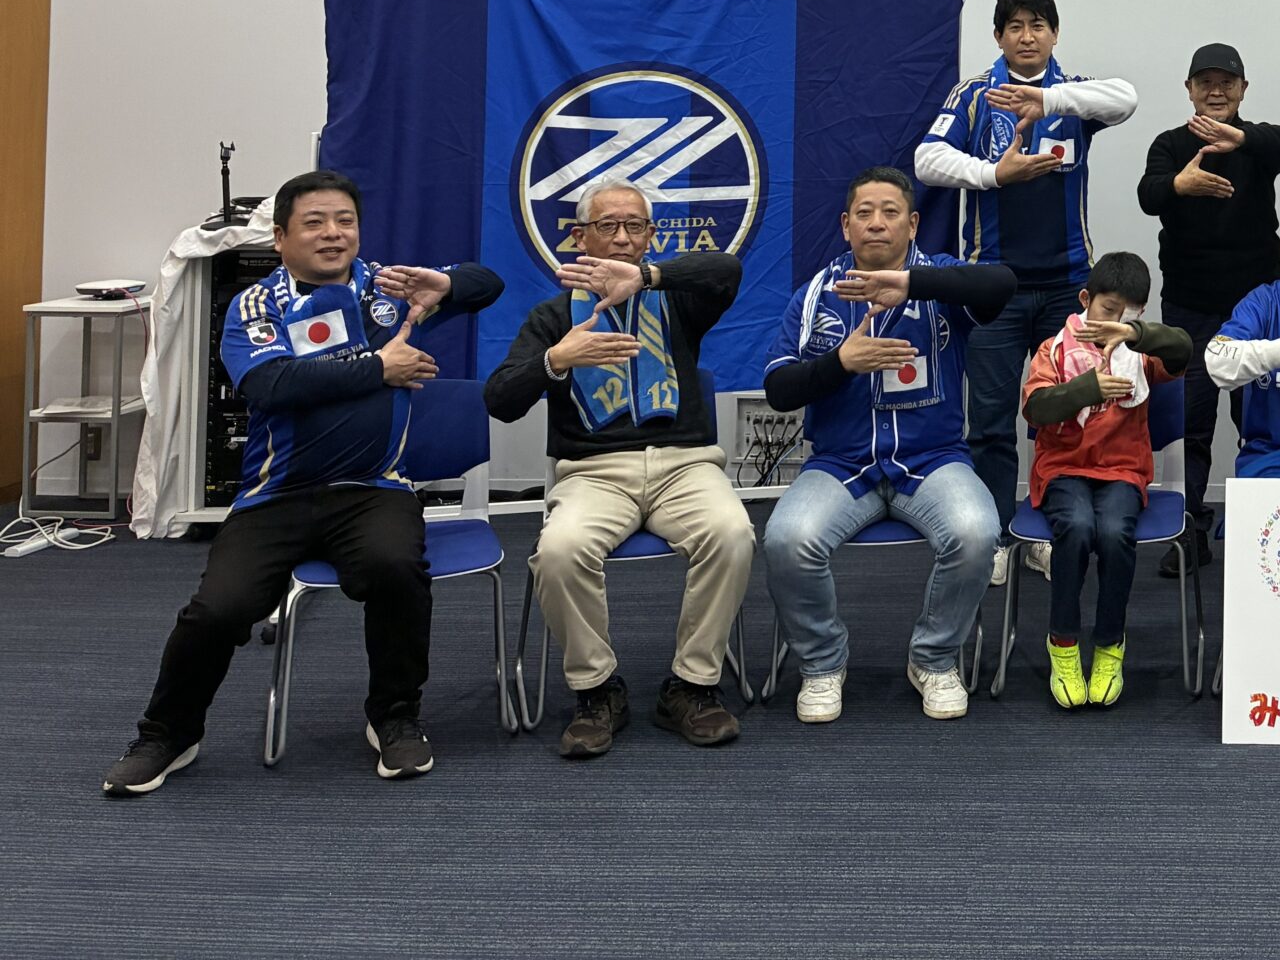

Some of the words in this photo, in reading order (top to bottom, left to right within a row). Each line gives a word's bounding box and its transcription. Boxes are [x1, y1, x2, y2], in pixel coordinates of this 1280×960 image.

[250, 344, 287, 359] MACHIDA
[336, 343, 365, 358] ZELVIA
[592, 377, 628, 415] 12
[648, 381, 677, 410] 12
[885, 401, 918, 411] MACHIDA
[918, 396, 941, 407] ZELVIA
